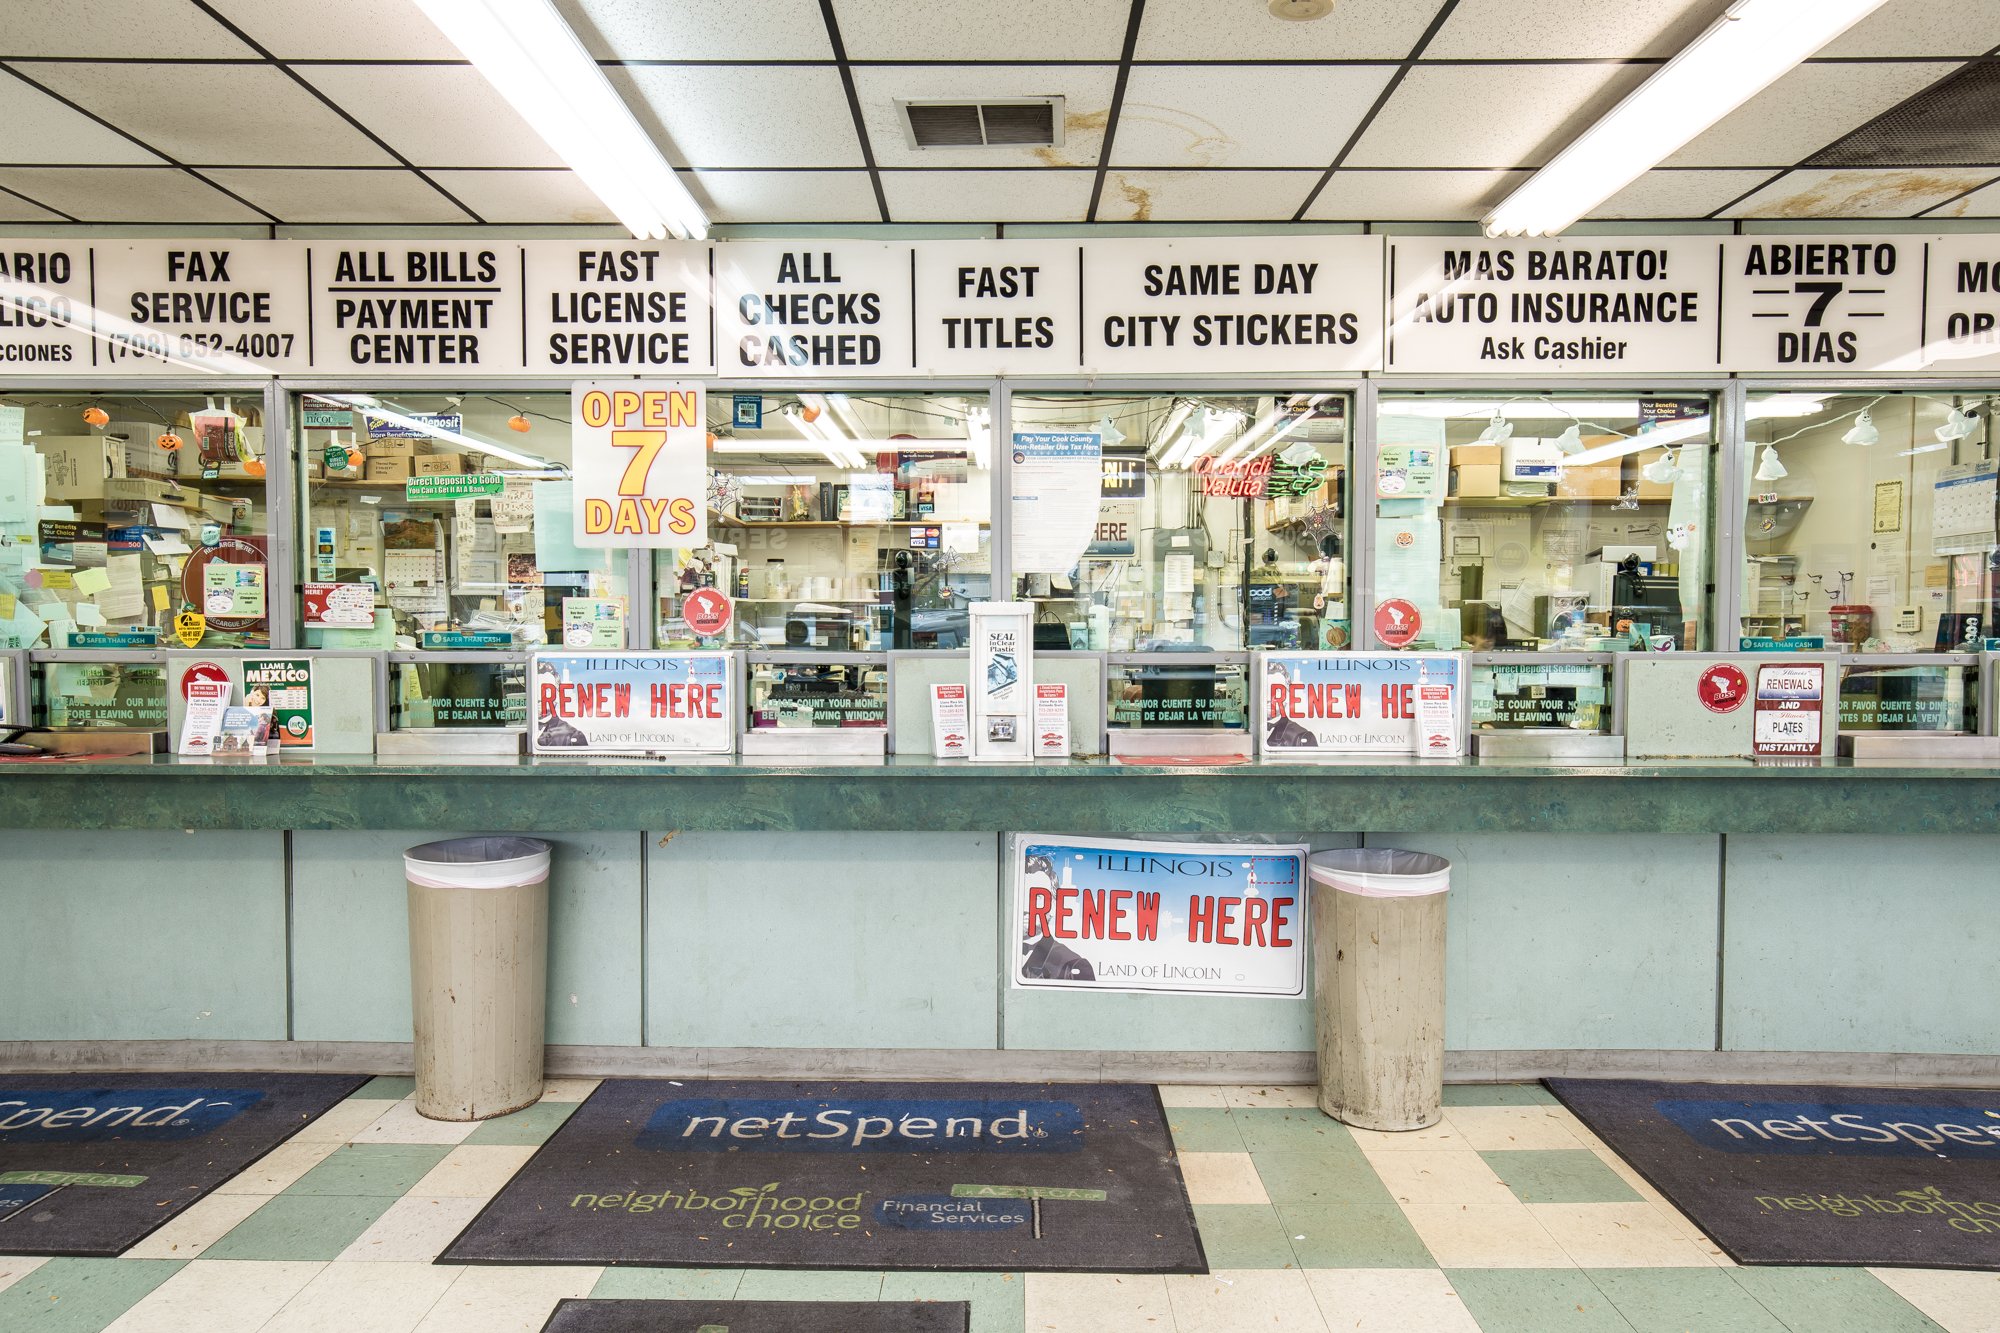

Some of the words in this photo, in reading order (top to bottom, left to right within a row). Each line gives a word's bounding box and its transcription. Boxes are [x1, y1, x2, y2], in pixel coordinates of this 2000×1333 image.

[168, 251, 231, 282] FAX
[335, 251, 394, 282] ALL
[408, 251, 496, 282] BILLS
[579, 251, 659, 282] FAST
[777, 252, 841, 283] ALL
[1444, 250, 1514, 281] MAS
[1528, 250, 1668, 281] BARATO!
[1744, 243, 1896, 276] ABIERTO
[958, 266, 1039, 298] FAST
[1144, 264, 1240, 296] SAME
[1254, 263, 1318, 295] DAY
[131, 292, 271, 323] SERVICE
[336, 299, 493, 329] PAYMENT
[552, 292, 686, 323] LICENSE
[739, 293, 881, 325] CHECKS
[1413, 293, 1498, 323] AUTO
[1511, 292, 1698, 323] INSURANCE
[1795, 282, 1843, 327] 7
[942, 316, 1054, 349] TITLES
[1104, 315, 1180, 347] CITY
[1193, 313, 1358, 346] STICKERS
[108, 333, 169, 363] (708)
[180, 333, 294, 359] 652-4007
[351, 334, 479, 364] CENTER
[550, 333, 689, 365] SERVICE
[739, 335, 881, 366] CASHED
[1480, 336, 1525, 360] Ask
[1534, 336, 1627, 360] Cashier
[1778, 331, 1857, 363] DIAS
[582, 391, 697, 427] OPEN
[1021, 435, 1034, 443] Pay
[1070, 435, 1093, 444] County
[1083, 443, 1100, 451] Here.
[612, 430, 667, 496] 7
[408, 477, 433, 485] Direct
[434, 476, 466, 486] Deposit
[467, 475, 478, 484] So
[1203, 476, 1263, 496] Valuta
[585, 498, 696, 534] DAYS
[463, 635, 480, 643] THAN
[246, 670, 308, 683] MEXICO
[586, 659, 679, 670] ILLINOIS
[1317, 659, 1411, 671] ILLINOIS
[1520, 665, 1551, 674] Deposit
[1714, 690, 1736, 700] BOSS
[1766, 679, 1813, 690] RENEWALS
[455, 699, 485, 707] CUENTE
[489, 699, 499, 707] SU
[541, 683, 631, 718] RENEW
[650, 683, 723, 719] HERE
[796, 699, 825, 707] COUNT
[829, 699, 851, 707] YOUR
[855, 699, 884, 707] MONEY
[1162, 700, 1192, 708] CUENTE
[1196, 700, 1206, 708] SU
[1271, 684, 1361, 718] RENEW
[1508, 700, 1536, 709] COUNT
[1540, 700, 1563, 709] YOUR
[1778, 701, 1800, 709] AND
[1852, 702, 1877, 710] FAVOR
[1881, 702, 1912, 710] CUENTE
[1915, 702, 1926, 710] SU
[96, 710, 133, 718] LEAVING
[438, 711, 449, 719] DE
[452, 711, 478, 719] DEJAR
[481, 711, 491, 719] LA
[845, 711, 884, 720] WINDOW
[1115, 712, 1141, 720] ANTES
[1144, 712, 1155, 720] DE
[1159, 712, 1184, 720] DEJAR
[1188, 712, 1198, 720] LA
[1514, 713, 1552, 722] LEAVING
[1862, 714, 1873, 722] DE
[1877, 714, 1903, 722] DEJAR
[1907, 714, 1917, 722] LA
[589, 732, 617, 743] LAND
[619, 732, 632, 743] OF
[634, 732, 675, 743] LINCOLN
[1320, 733, 1347, 744] LAND
[1349, 733, 1362, 744] OF
[1364, 733, 1406, 744] LINCOLN
[1772, 722, 1803, 733] PLATES
[1758, 743, 1816, 752] INSTANTLY
[1097, 854, 1233, 878] ILLINOIS
[1027, 887, 1160, 941] RENEW
[1188, 895, 1294, 947] HERE
[1098, 961, 1137, 977] LAND
[1141, 965, 1159, 978] OF
[1162, 964, 1221, 980] LINCOLN
[682, 1109, 1029, 1147] netSpend
[571, 1189, 863, 1213] neighborhood
[882, 1200, 981, 1212] Financial
[722, 1204, 861, 1229] choice
[931, 1213, 1024, 1224] Services
